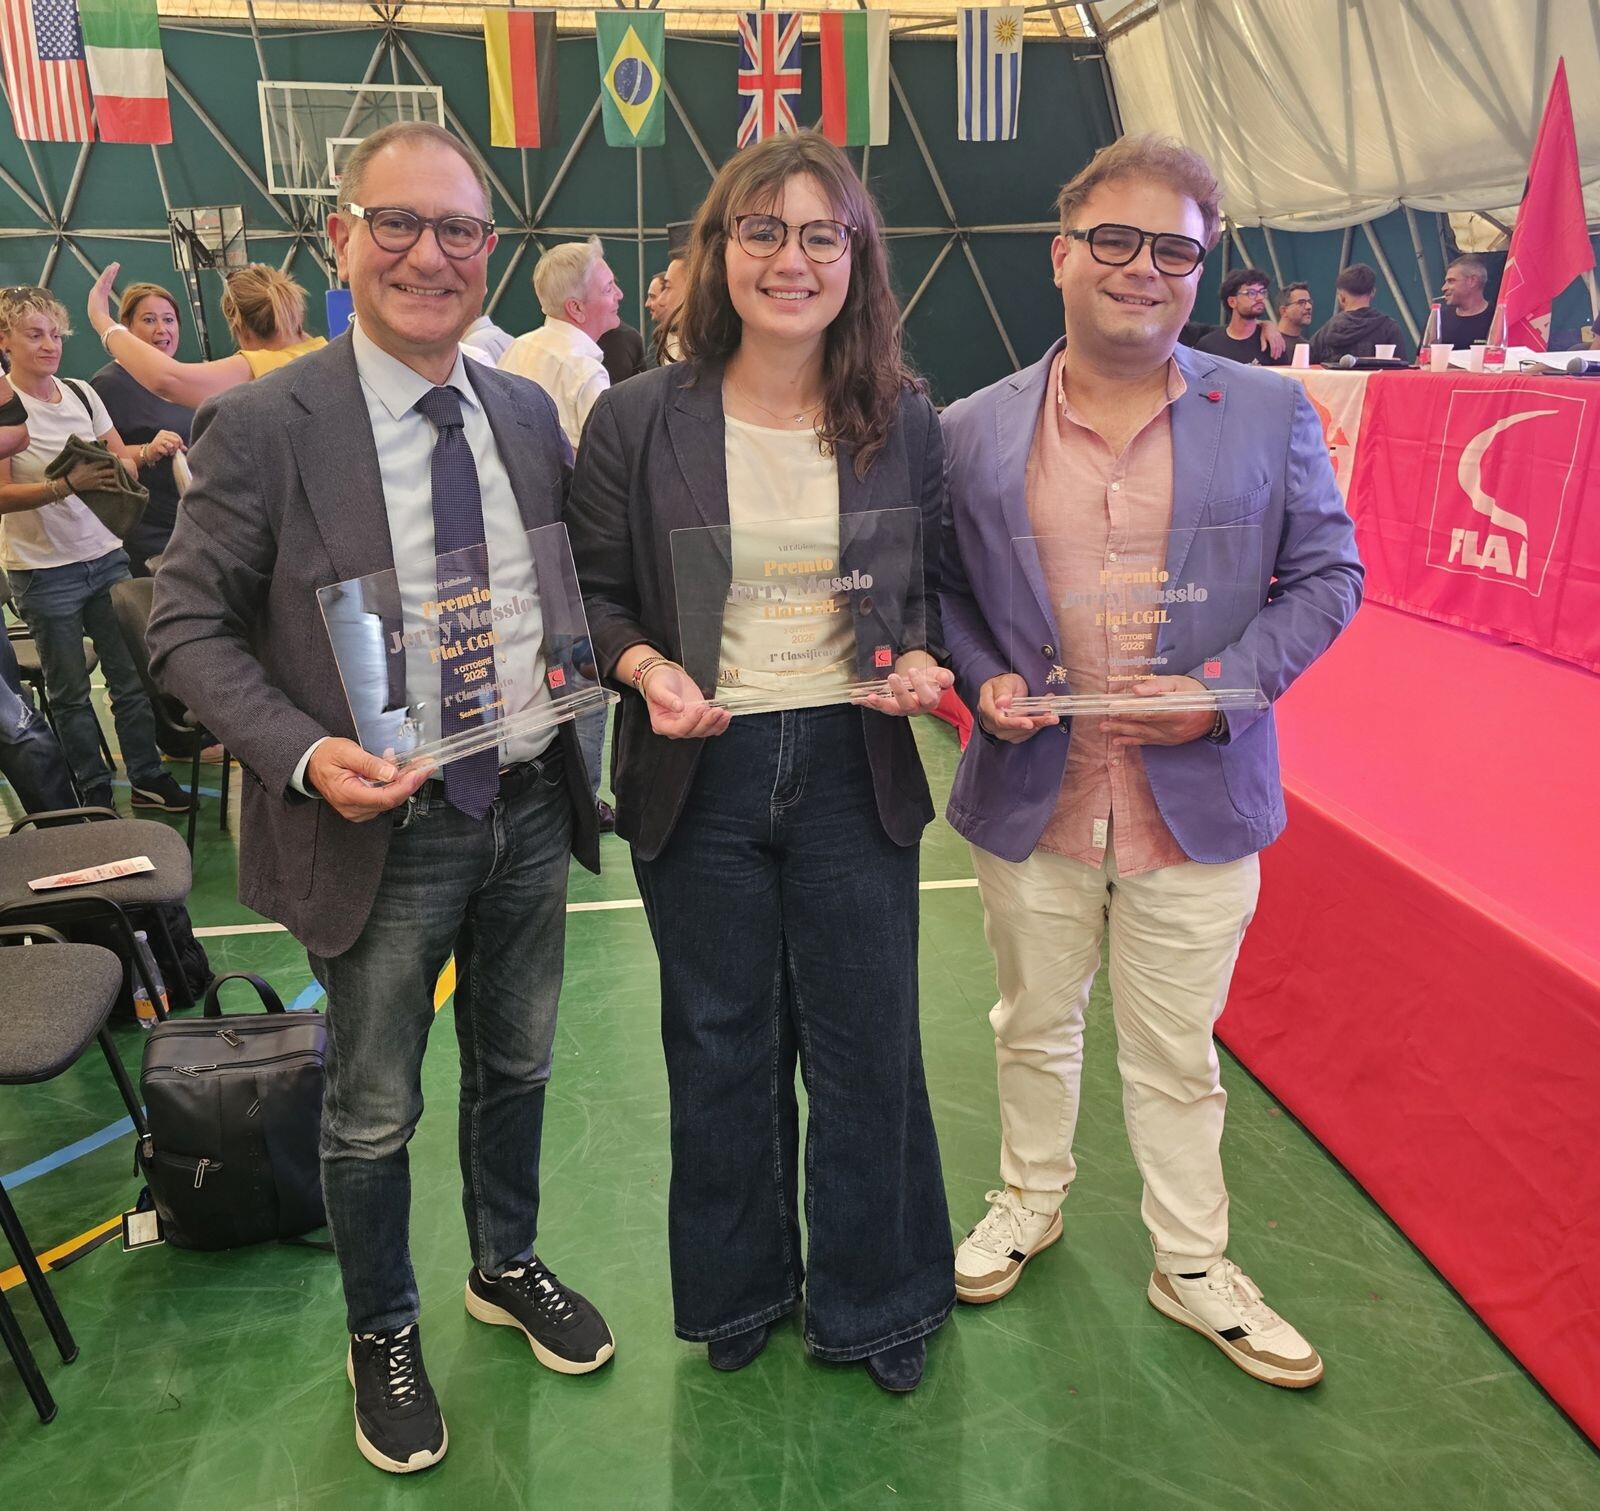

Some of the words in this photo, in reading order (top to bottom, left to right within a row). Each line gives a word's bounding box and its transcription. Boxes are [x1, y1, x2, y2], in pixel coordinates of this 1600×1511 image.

[1448, 528, 1528, 580] FLAI
[764, 556, 834, 577] Premio
[1100, 566, 1169, 584] Premio
[796, 569, 874, 595] Masslo
[421, 587, 491, 619] Premio
[1095, 610, 1172, 626] Flai-CGIL
[389, 620, 453, 654] Jerry
[1119, 633, 1153, 641] OTTOBRE
[1120, 642, 1145, 650] 2026
[459, 656, 493, 673] OTTOBRE
[463, 668, 489, 683] 2026
